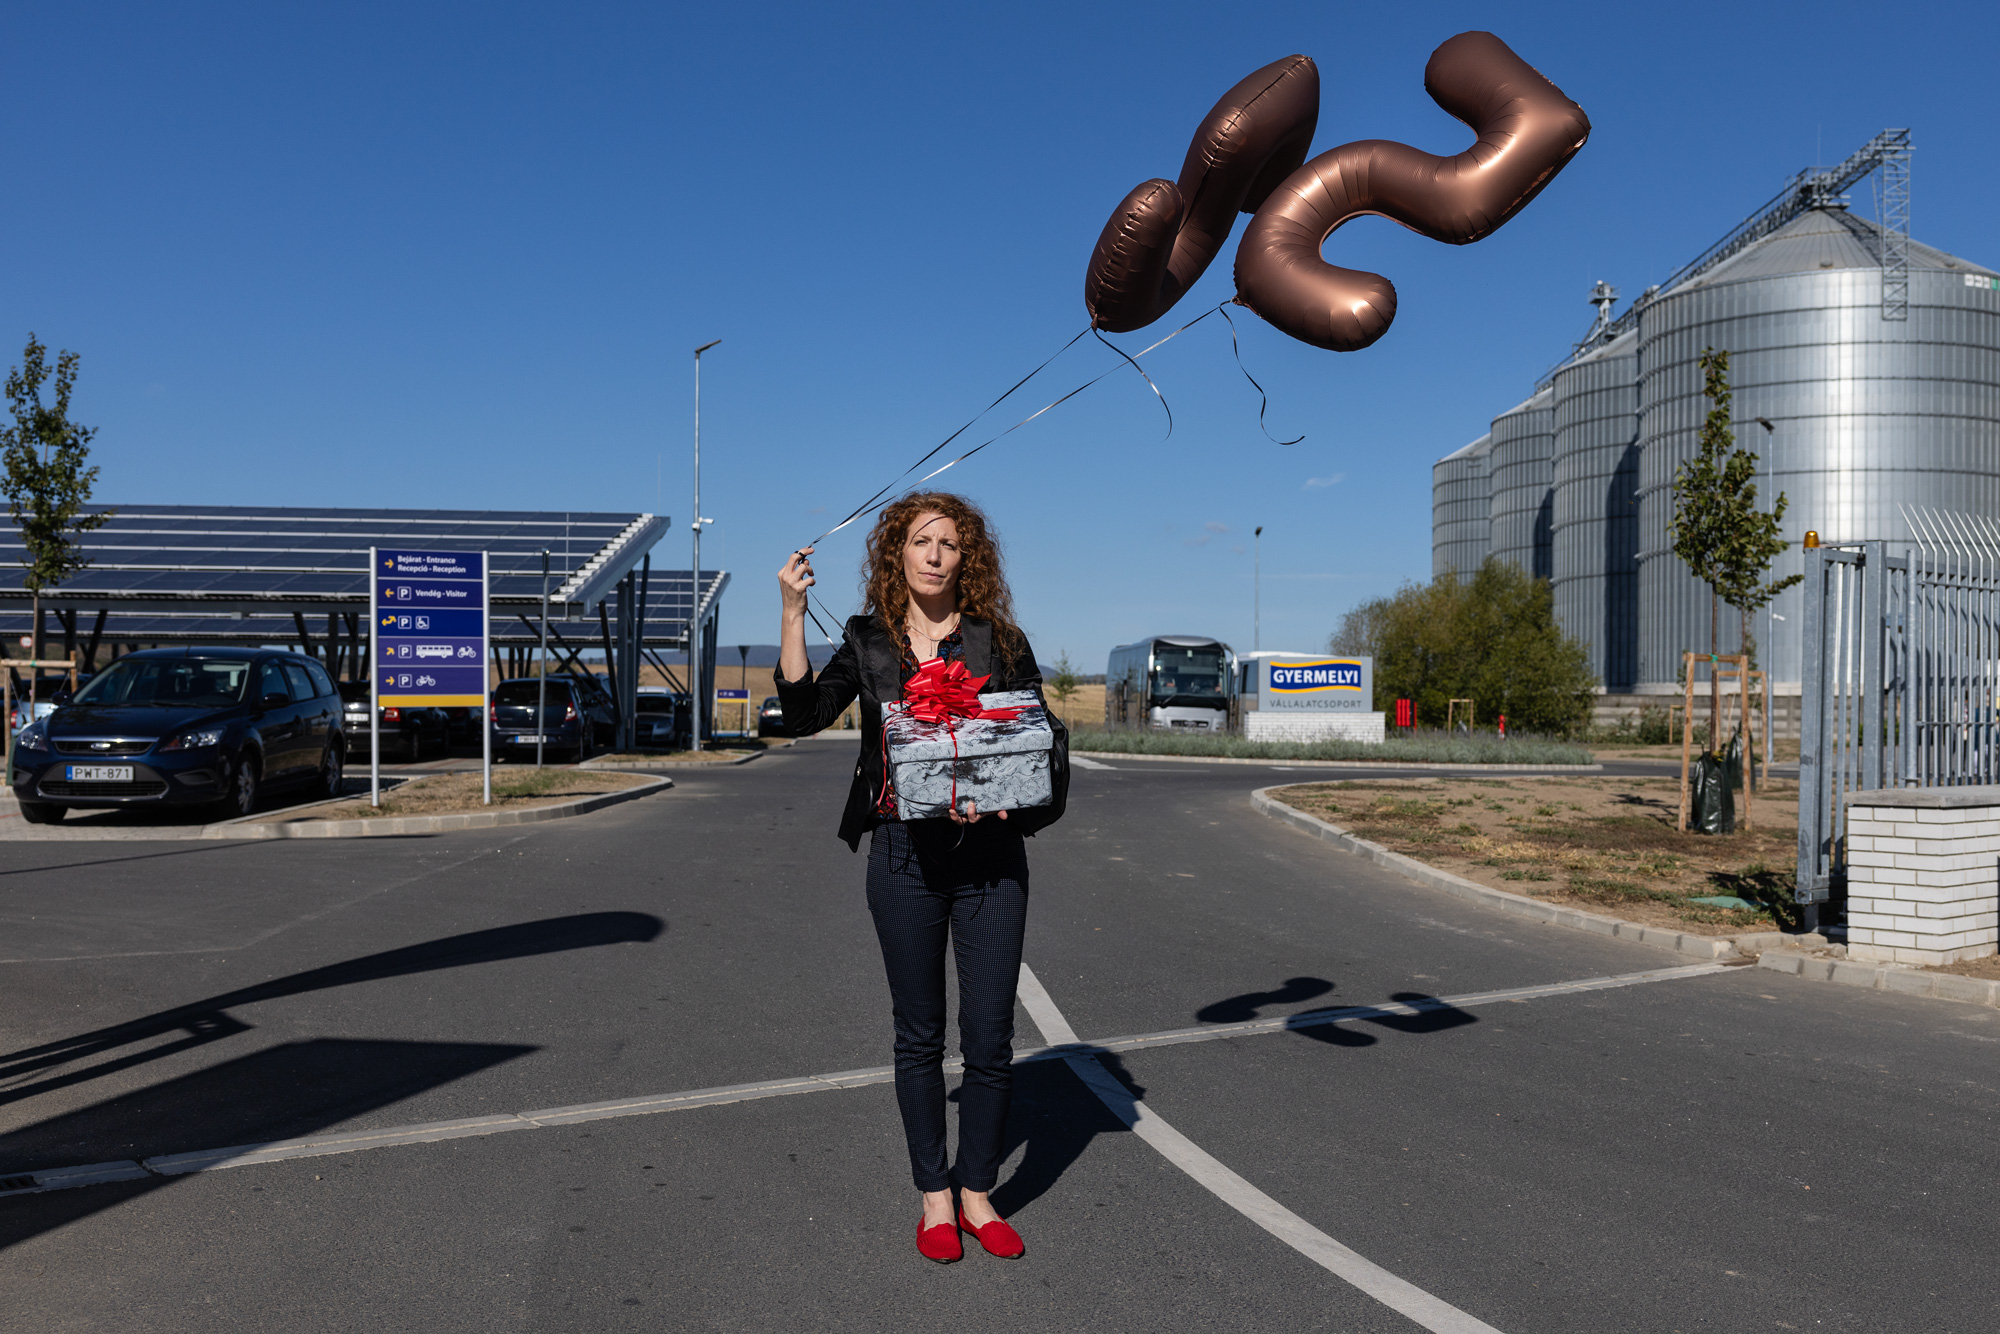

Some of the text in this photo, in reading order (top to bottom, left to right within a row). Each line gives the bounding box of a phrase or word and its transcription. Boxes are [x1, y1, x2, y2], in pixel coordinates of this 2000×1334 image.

[397, 555, 422, 564] Bejárat
[426, 556, 456, 564] Entrance
[397, 564, 428, 573] Recepció
[432, 565, 467, 574] Reception
[400, 588, 408, 598] P
[415, 589, 441, 599] Vendég
[445, 590, 467, 598] Visitor
[401, 617, 409, 627] P
[401, 647, 409, 656] P
[401, 676, 409, 686] P
[1273, 669, 1359, 684] GYERMELYI
[1269, 698, 1362, 708] VÁLLALATCSOPORT
[75, 767, 129, 779] PWT-871
